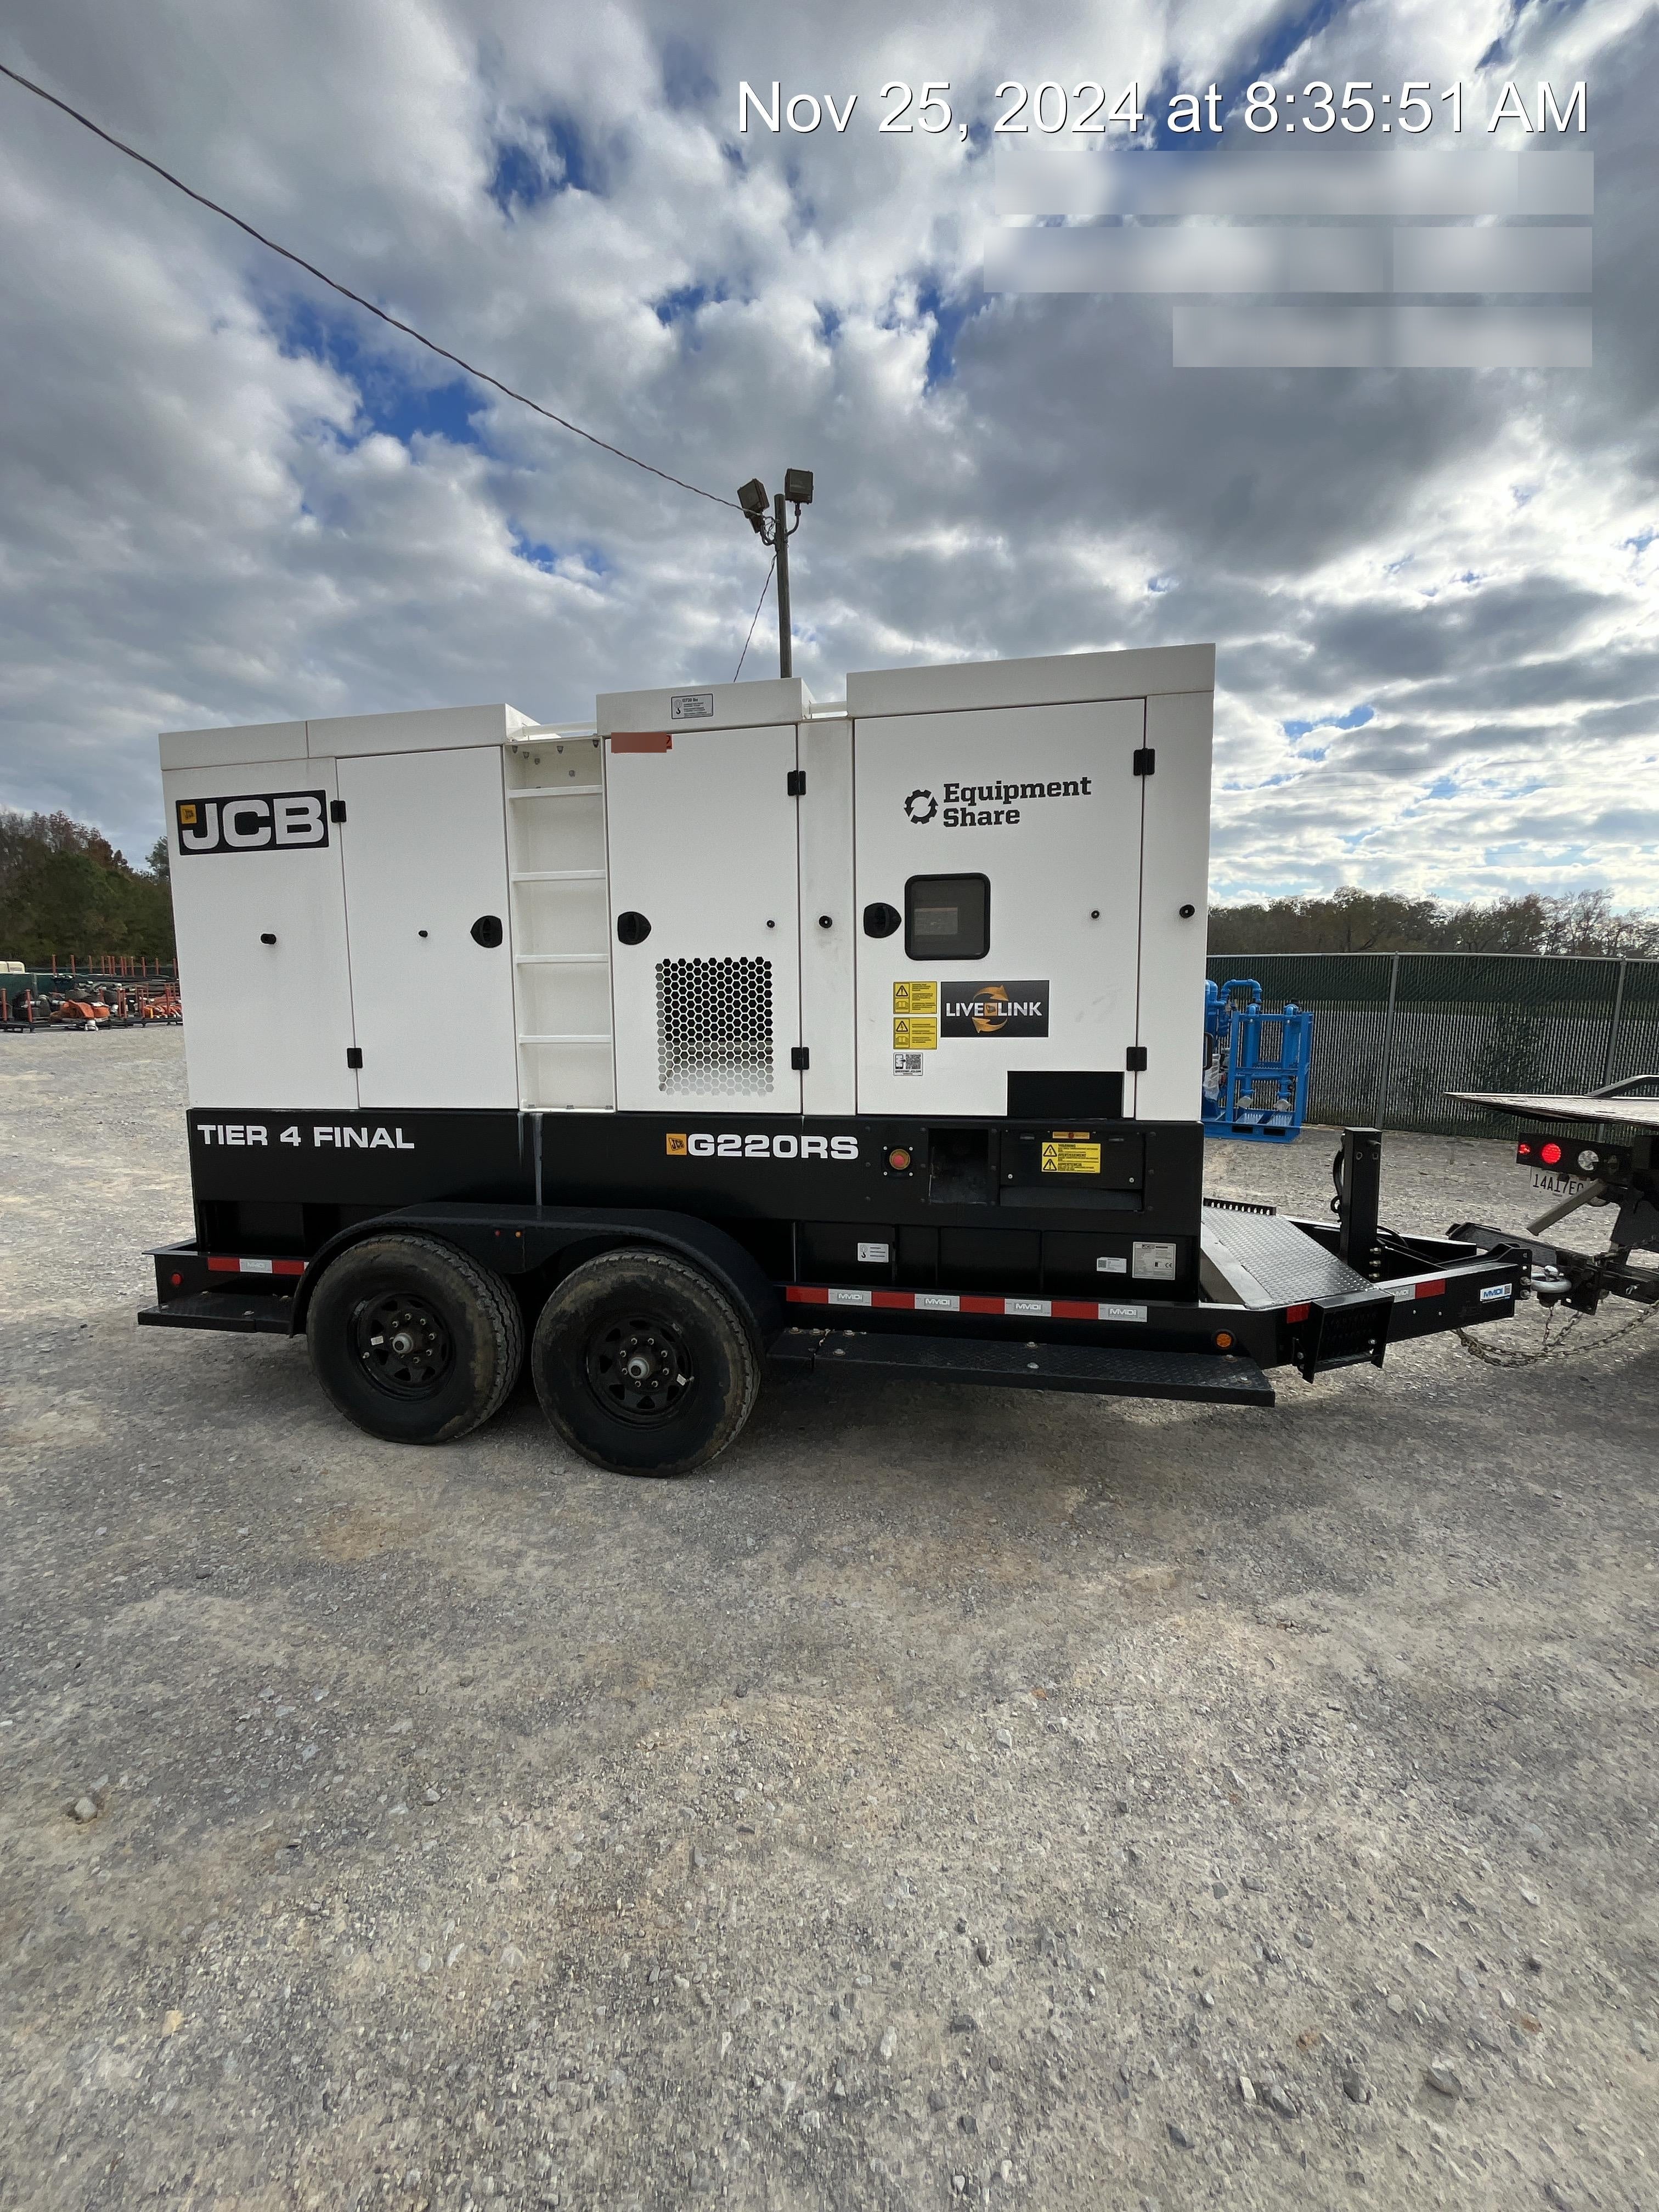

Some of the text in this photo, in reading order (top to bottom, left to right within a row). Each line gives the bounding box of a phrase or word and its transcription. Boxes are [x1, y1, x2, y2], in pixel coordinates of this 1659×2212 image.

[943, 777, 1092, 806] Equipment
[182, 797, 324, 850] JCB
[943, 807, 1020, 827] Share
[946, 1002, 984, 1017] LIVE
[997, 1002, 1042, 1017] LINK
[197, 1125, 415, 1149] TIER 4 FINAL
[688, 1133, 859, 1159] G220RS
